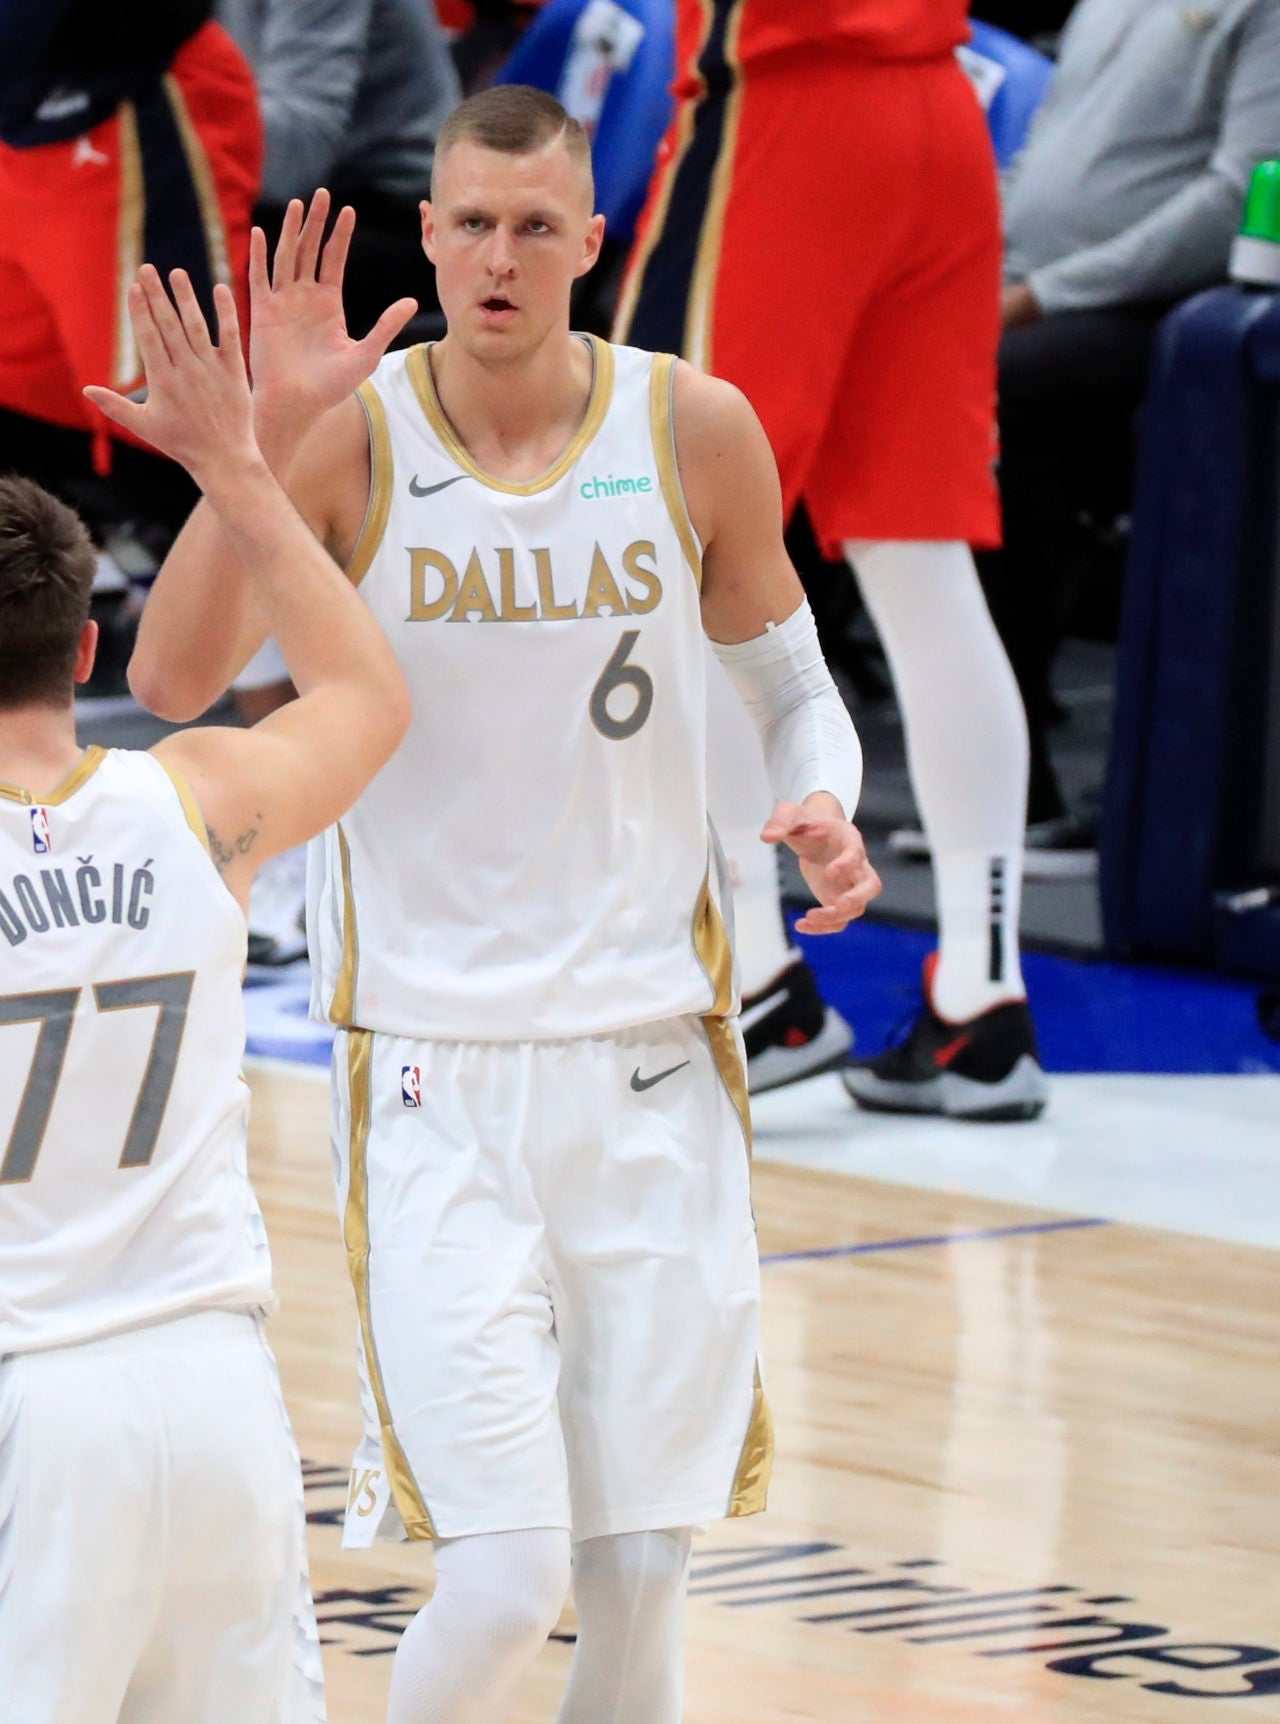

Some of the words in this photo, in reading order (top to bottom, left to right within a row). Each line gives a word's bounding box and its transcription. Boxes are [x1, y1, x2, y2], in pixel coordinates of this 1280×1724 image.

[580, 474, 653, 500] chime
[404, 539, 663, 623] DALLAS
[588, 629, 654, 741] 6
